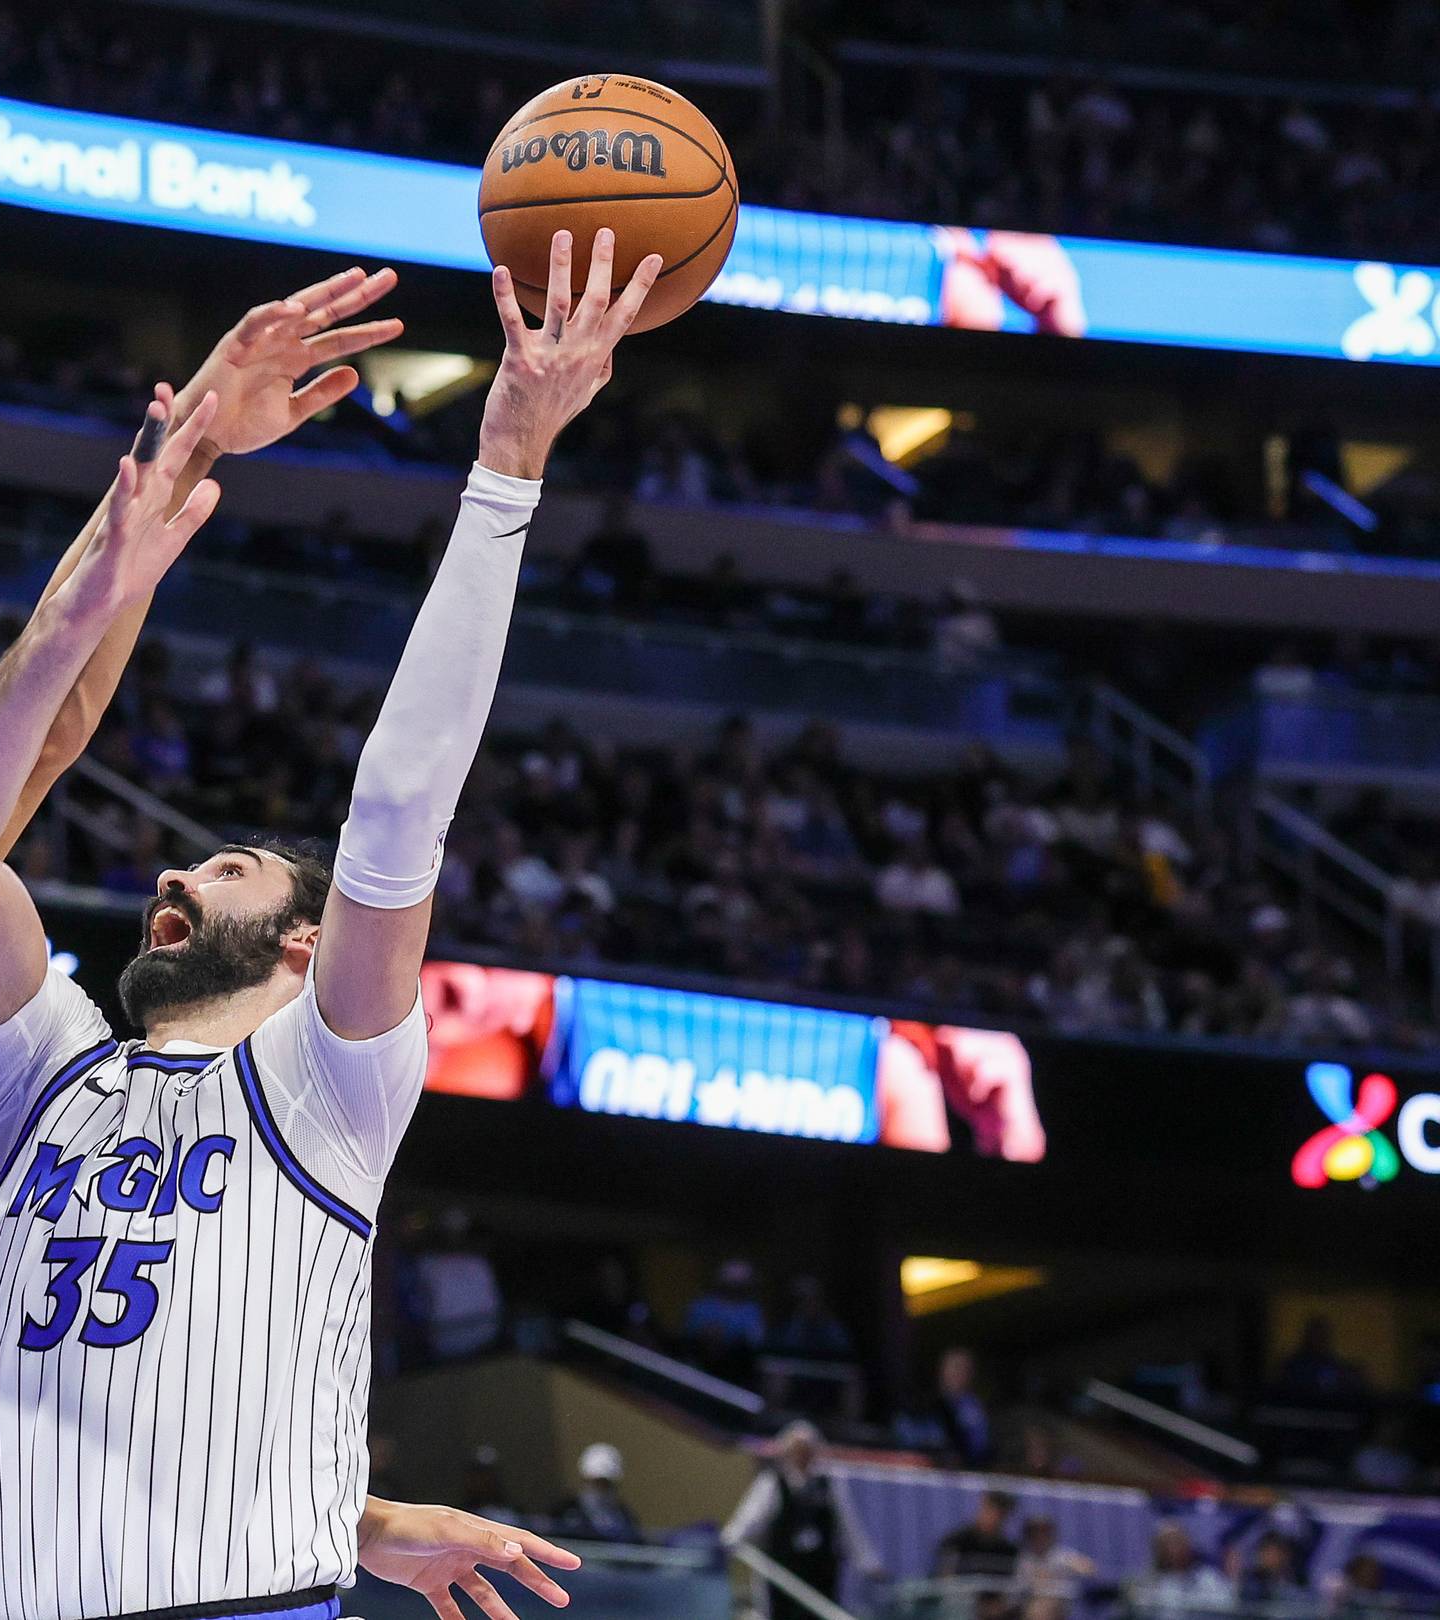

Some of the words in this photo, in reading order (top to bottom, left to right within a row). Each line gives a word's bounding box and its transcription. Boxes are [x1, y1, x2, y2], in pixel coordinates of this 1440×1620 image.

[148, 141, 318, 228] Bank
[502, 128, 666, 178] Wilson
[17, 1236, 176, 1351] 35
